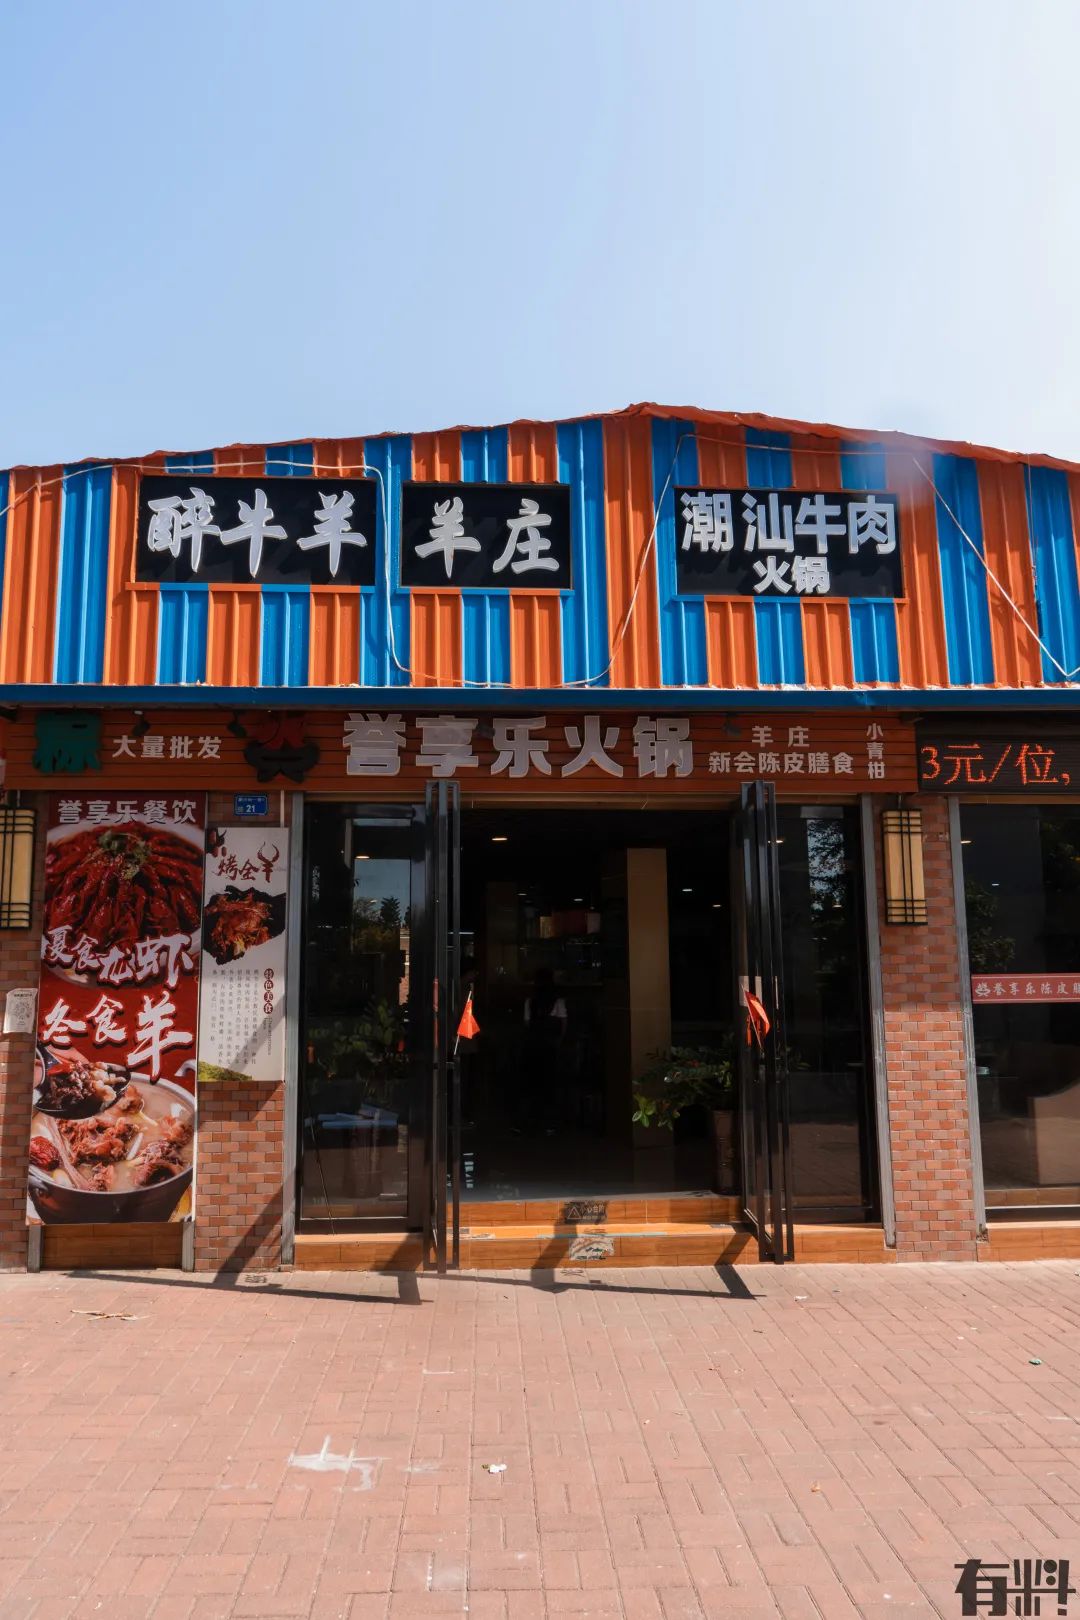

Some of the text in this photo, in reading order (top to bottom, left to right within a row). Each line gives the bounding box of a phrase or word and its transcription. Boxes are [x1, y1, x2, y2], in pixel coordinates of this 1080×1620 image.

[147, 486, 368, 578] 醉牛羊
[414, 496, 560, 579] 羊庄
[680, 492, 897, 555] 潮汕牛肉
[753, 555, 830, 594] 火锅
[112, 734, 222, 759] 大量批发
[342, 712, 694, 778] 誉享乐火锅
[751, 725, 810, 747] 羊庄
[866, 723, 886, 780] 小青柑
[708, 751, 855, 775] 新会陈皮膳食
[58, 799, 197, 825] 誉享乐餐饮
[245, 804, 256, 813] 21
[215, 841, 280, 883] 烤全羊
[43, 991, 193, 1077] 冬食羊
